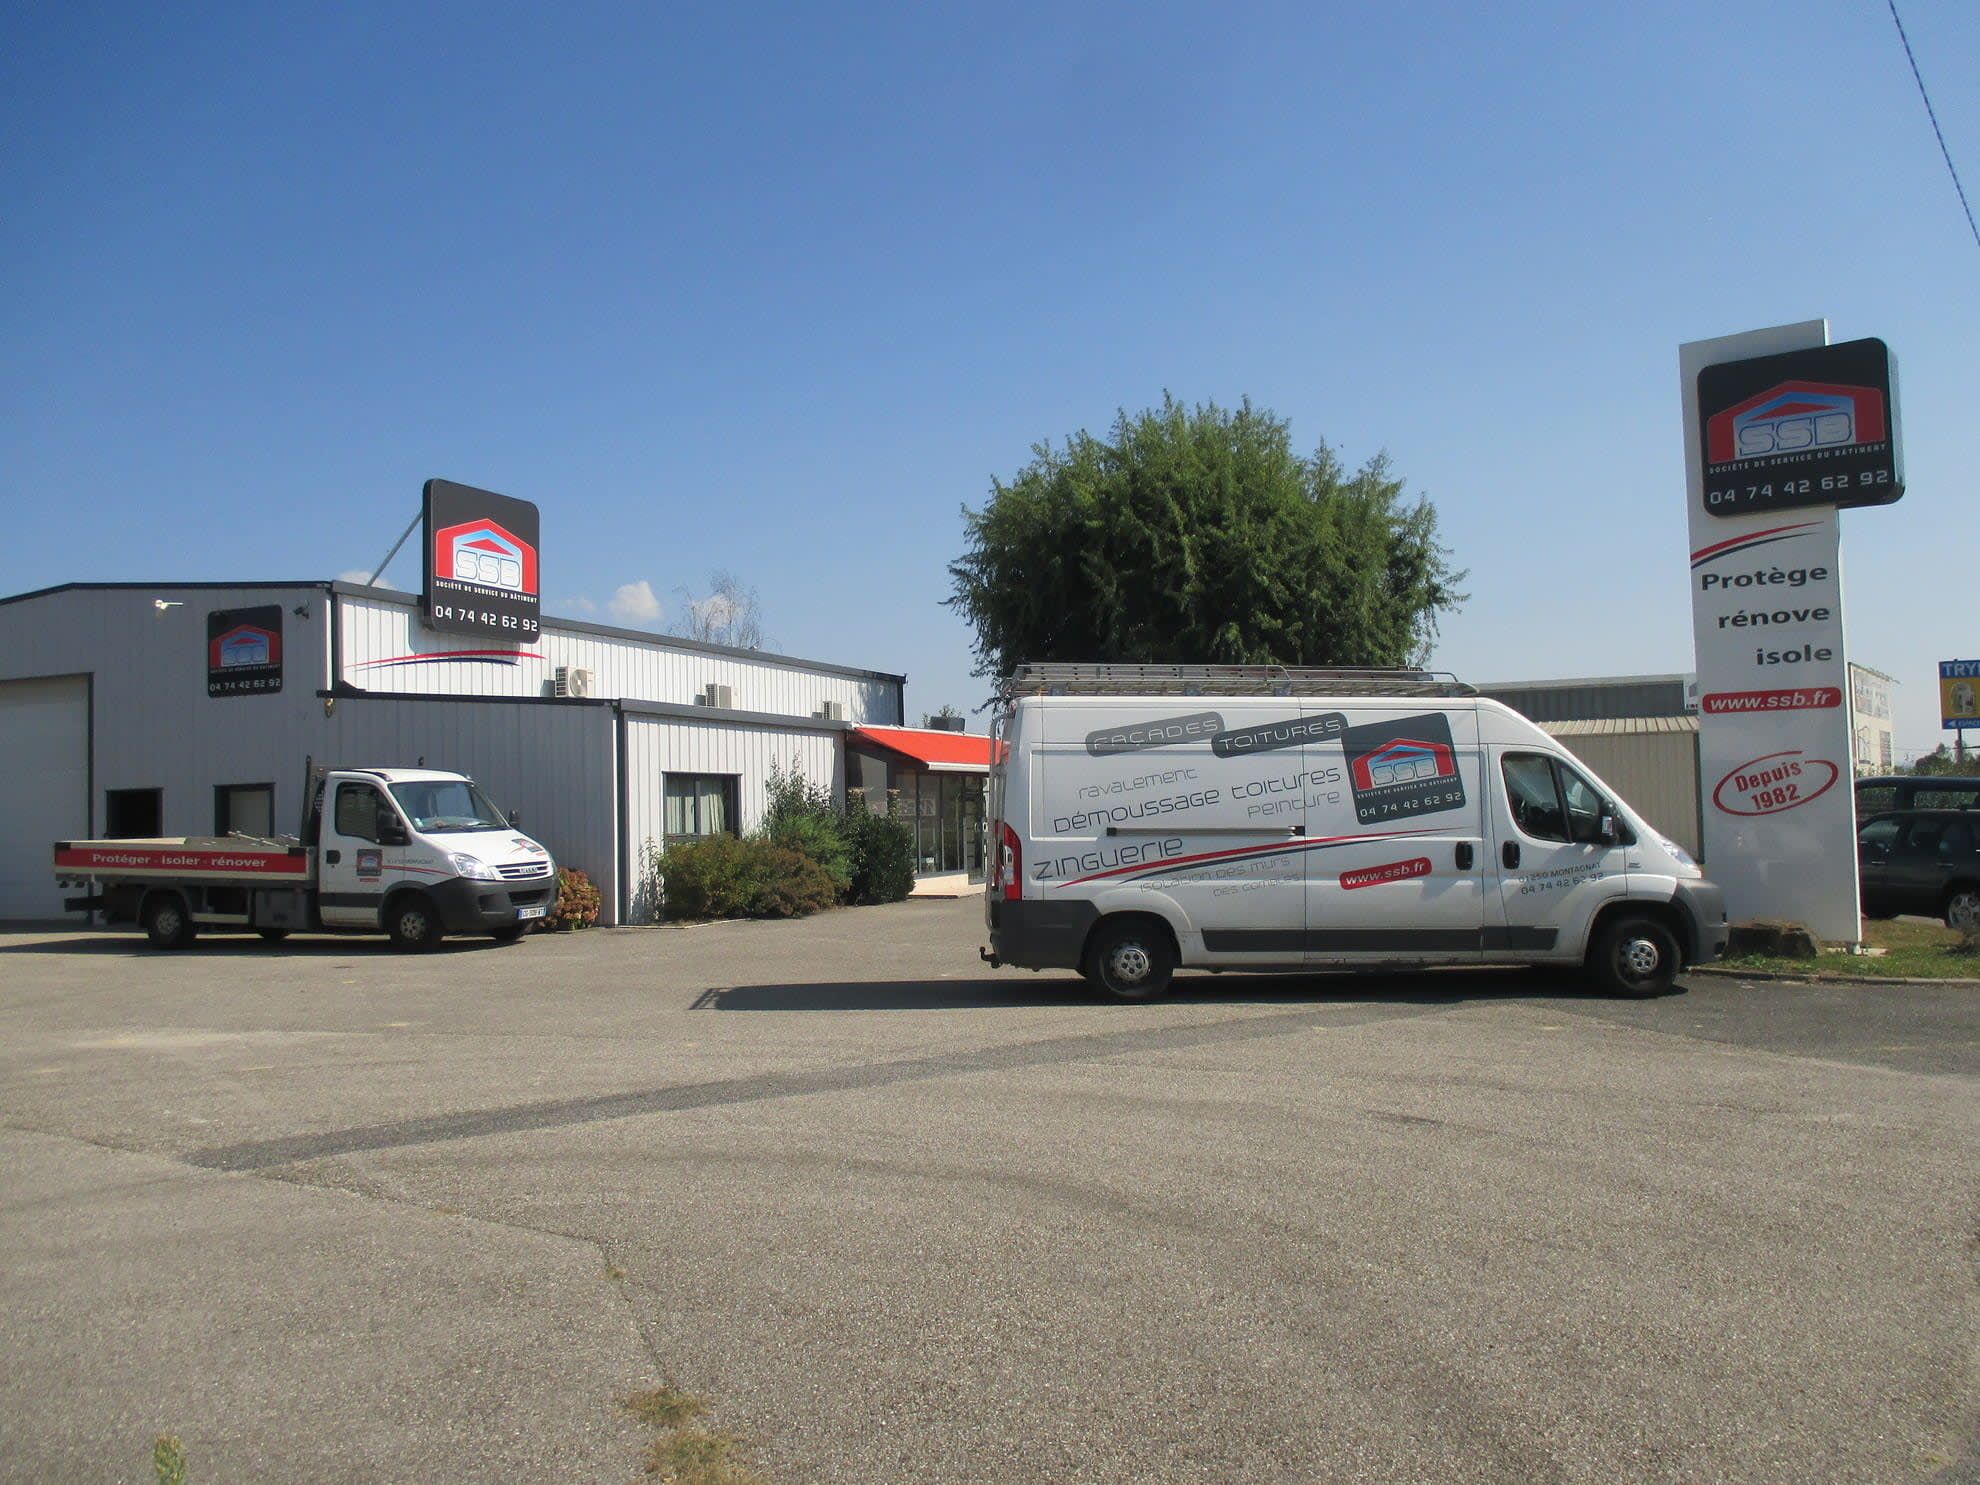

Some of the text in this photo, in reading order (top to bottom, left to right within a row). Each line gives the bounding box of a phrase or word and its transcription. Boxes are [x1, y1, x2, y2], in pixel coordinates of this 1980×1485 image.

[1738, 412, 1853, 456] SSB
[1709, 462, 1749, 474] SOCIÉTÉ
[1771, 454, 1812, 466] SERVICE
[1710, 470, 1888, 504] 04 74 42 62 92
[455, 549, 521, 587] SSB
[1702, 566, 1828, 591] Protège
[474, 586, 498, 597] SERVICE
[435, 606, 538, 632] 04 74 42 62 92
[1718, 607, 1830, 629] rénove
[1756, 644, 1832, 665] isole
[1942, 662, 1980, 677] TRY
[209, 683, 221, 692] 04
[224, 682, 236, 690] 74
[239, 680, 251, 689] 42
[254, 679, 265, 688] 62
[1710, 690, 1831, 711] www.ssb.fr
[1093, 719, 1219, 750] FAÇADES
[1219, 719, 1341, 751] TOITURES
[1734, 761, 1802, 792] Depuis
[1360, 791, 1461, 817] 04 74 42 62 92
[1751, 784, 1801, 811] 1982
[92, 853, 151, 865] Protéger
[161, 855, 200, 866] isoler
[211, 855, 267, 867] rénover
[1346, 861, 1425, 885] www.ssb.fr
[1539, 882, 1553, 891] 74
